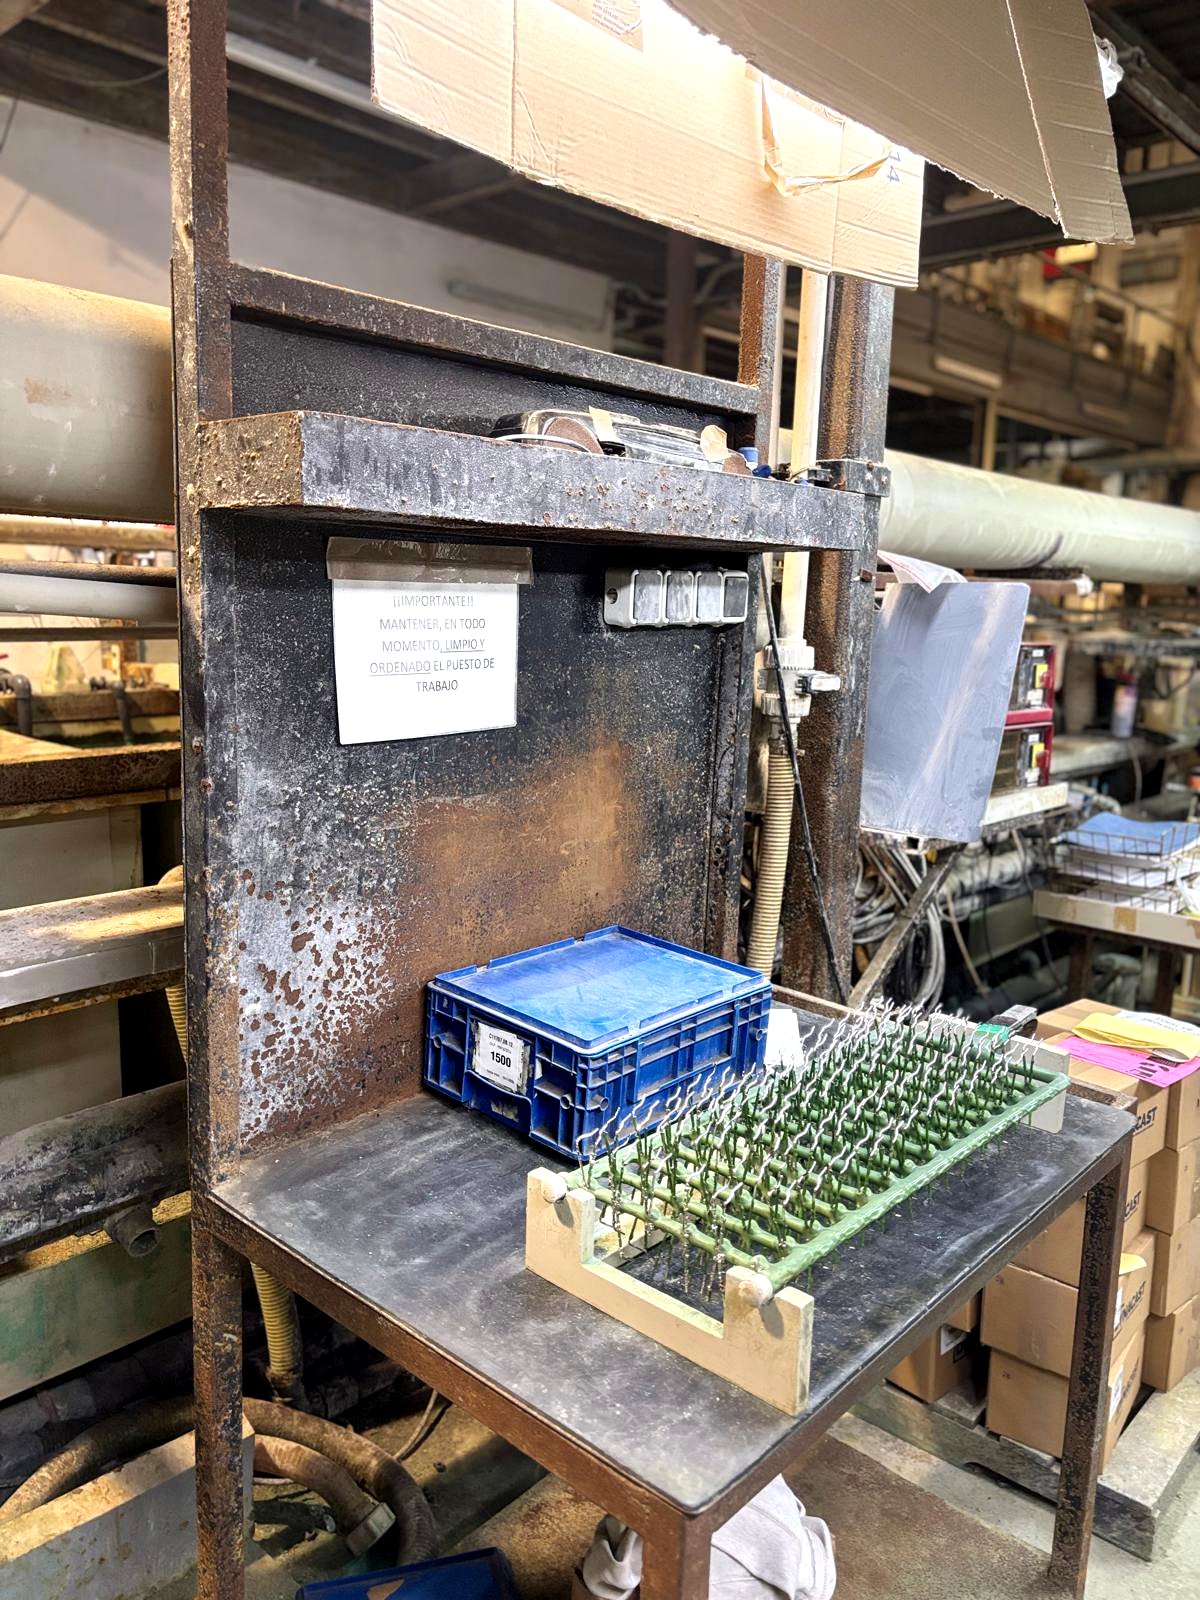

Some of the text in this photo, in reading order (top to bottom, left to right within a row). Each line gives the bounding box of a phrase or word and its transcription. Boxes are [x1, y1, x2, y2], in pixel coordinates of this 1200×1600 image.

[393, 595, 474, 608] ¡¡IMPORTANTE!!
[379, 618, 486, 631] MANTENER, EN TODO
[382, 638, 485, 653] MOMENTO, LIMPIO Y
[369, 657, 495, 674] ORDENADO EL PUESTO DE
[415, 679, 459, 693] TRABAJO
[490, 1051, 511, 1068] 1500
[1134, 1106, 1158, 1131] CAST
